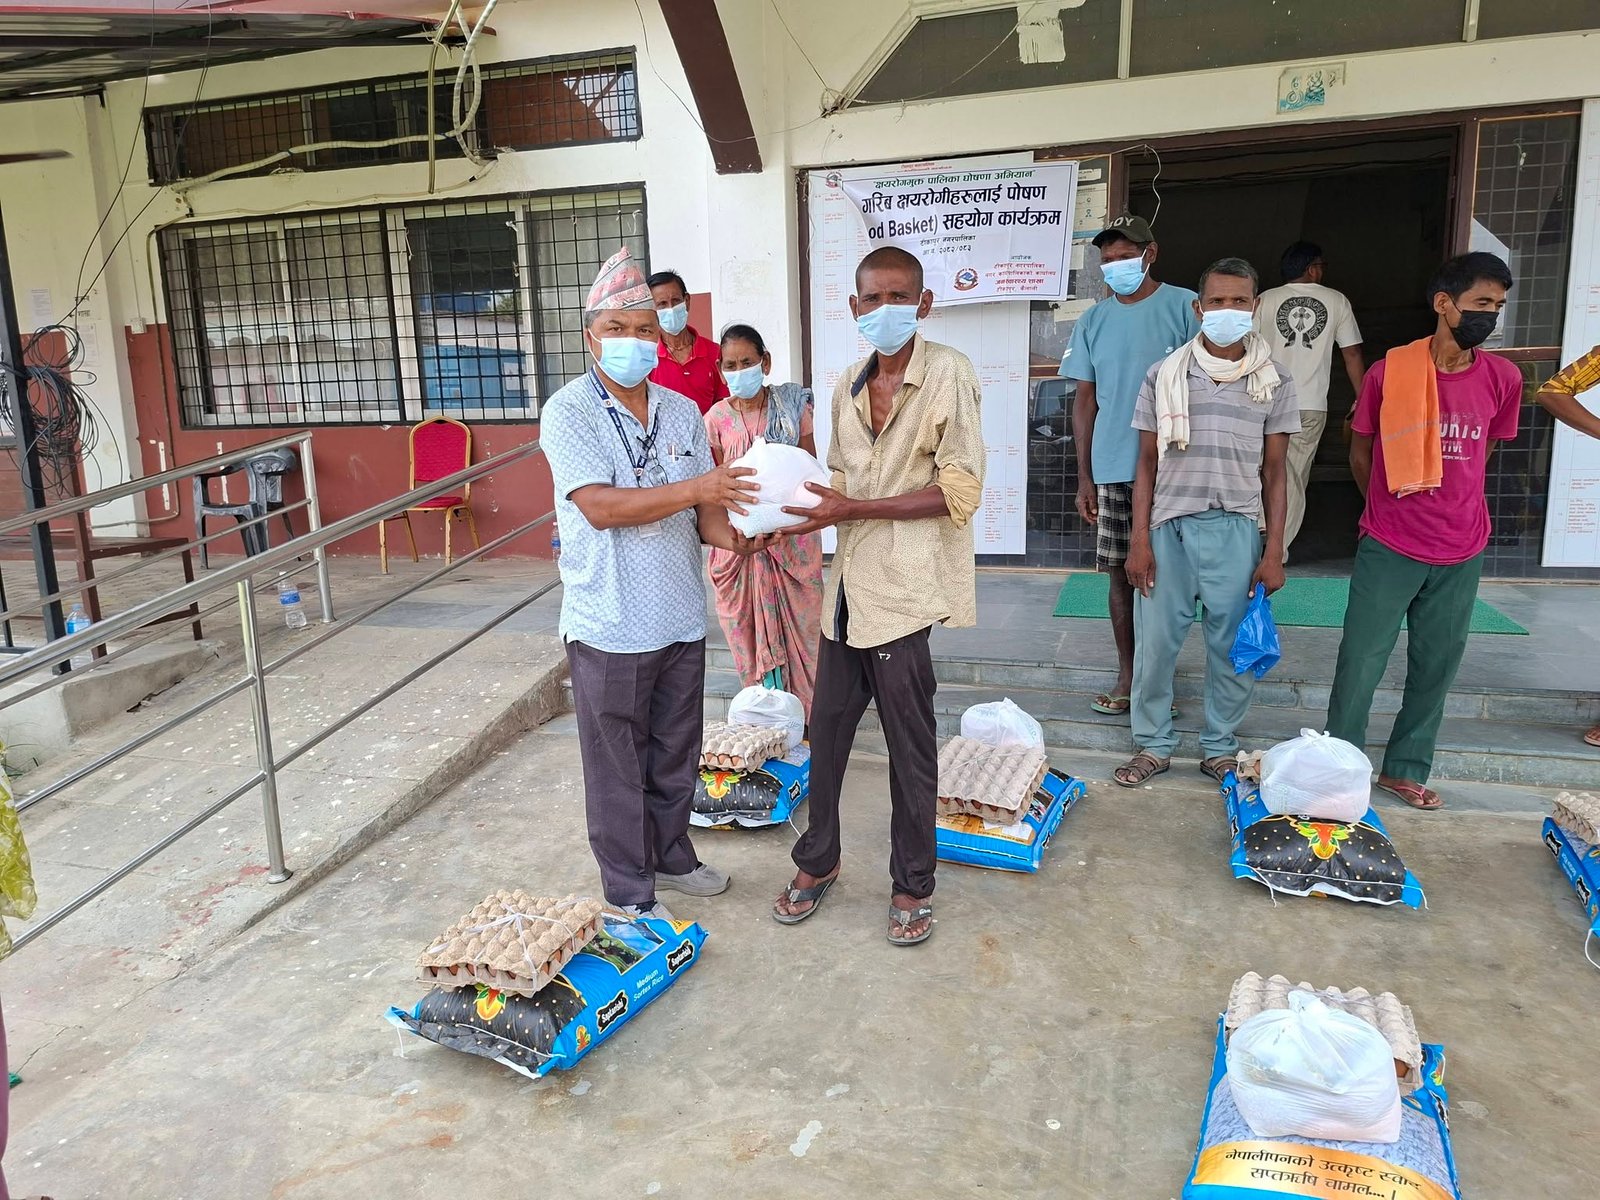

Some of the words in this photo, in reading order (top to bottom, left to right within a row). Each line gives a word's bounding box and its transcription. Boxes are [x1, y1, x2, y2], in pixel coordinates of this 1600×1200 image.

[928, 173, 960, 185] पालिका
[963, 171, 991, 182] घोषणा
[862, 192, 892, 214] गरिब
[1007, 182, 1048, 201] पोषण
[868, 221, 885, 240] od
[889, 214, 939, 238] Basket)
[943, 208, 993, 230] सहयोग
[998, 206, 1062, 227] कार्यक्रम
[633, 984, 652, 1002] Sortex
[651, 974, 665, 988] Rice
[636, 969, 659, 989] Medium
[1225, 1149, 1314, 1168] नेपालीपनको
[1319, 1159, 1375, 1178] उत्कृष्ट
[1250, 1167, 1318, 1187] सप्तऋषि
